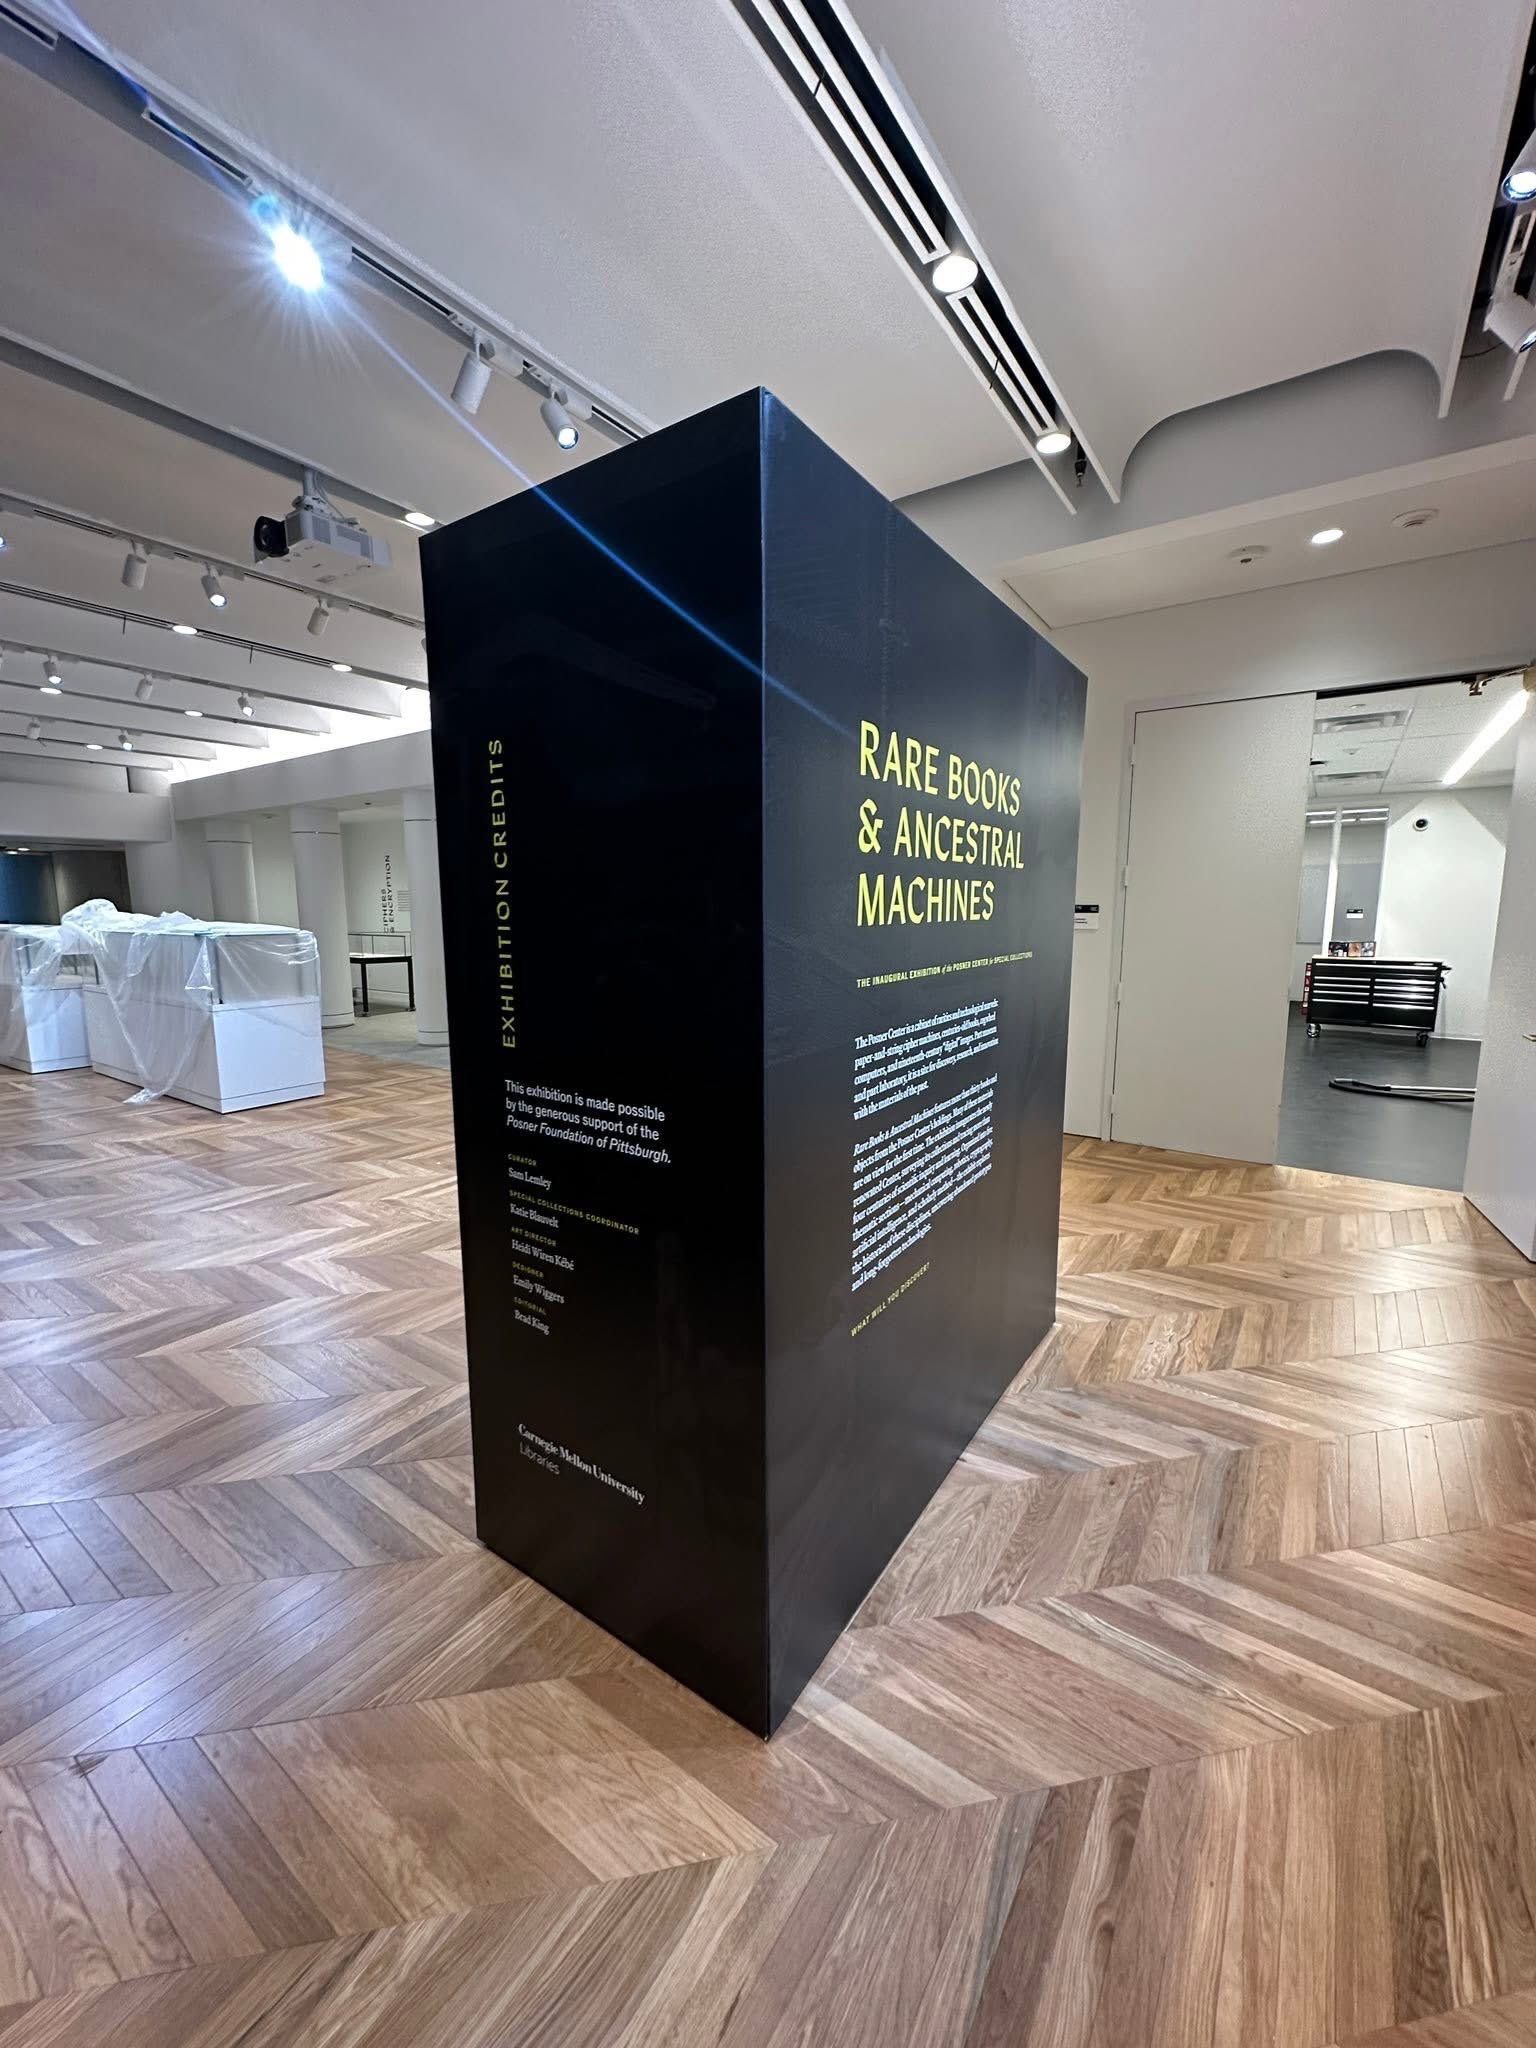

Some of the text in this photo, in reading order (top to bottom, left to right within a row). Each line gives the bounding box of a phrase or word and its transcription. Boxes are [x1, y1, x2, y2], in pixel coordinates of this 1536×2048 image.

[860, 720, 1021, 817] RARE BOOKS
[858, 798, 1025, 869] & ANCESTRAL
[489, 740, 516, 1048] EXHIBITION CREDITS
[857, 872, 995, 927] MACHINES
[857, 977, 870, 987] THE
[873, 972, 908, 985] INAUGURAL
[855, 1036, 868, 1049] The
[855, 1043, 903, 1070] paper-and-string
[505, 1079, 665, 1122] This exhibition is made possible
[854, 1087, 866, 1103] and
[866, 1085, 879, 1101] part
[505, 1097, 660, 1140] by the generous support of the
[854, 1105, 868, 1120] with
[507, 1115, 671, 1164] Posner Foundation of Pittsburgh.
[508, 1153, 537, 1166] CURATOR
[508, 1167, 551, 1190] Sam Lemley
[509, 1190, 640, 1235] SPECIAL COLLECTIONS COORDINATOR
[510, 1203, 528, 1218] Katie
[511, 1239, 531, 1255] Heidi
[524, 1230, 557, 1247] DIRECTOR
[513, 1274, 534, 1293] Emily
[518, 1423, 645, 1505] Carnegie Mellon University
[520, 1441, 560, 1475] Libraries
